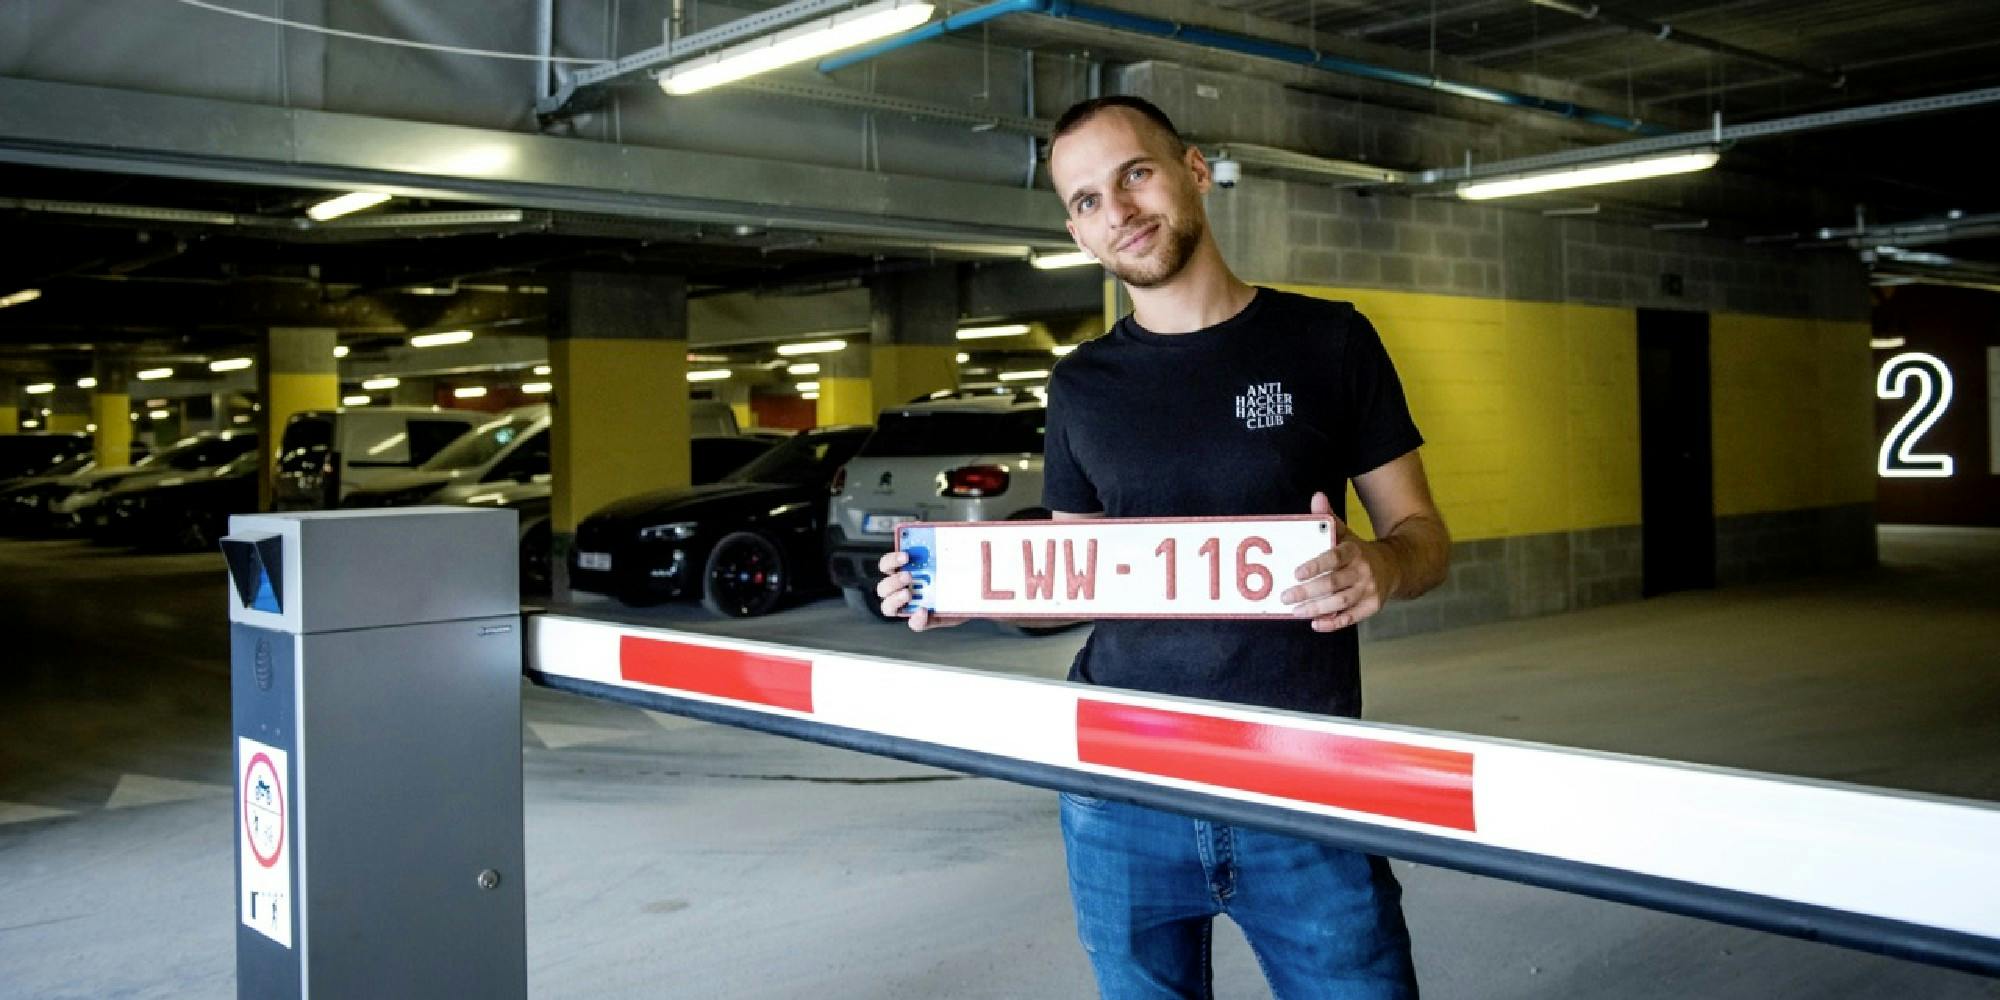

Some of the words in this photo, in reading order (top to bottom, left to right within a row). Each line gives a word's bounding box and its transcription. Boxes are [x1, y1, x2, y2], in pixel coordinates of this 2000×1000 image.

[1247, 382, 1281, 396] ANTI
[1236, 393, 1292, 408] HACKER
[1236, 404, 1294, 418] HACKER
[1877, 352, 1953, 477] 2
[1247, 416, 1284, 429] CLUB
